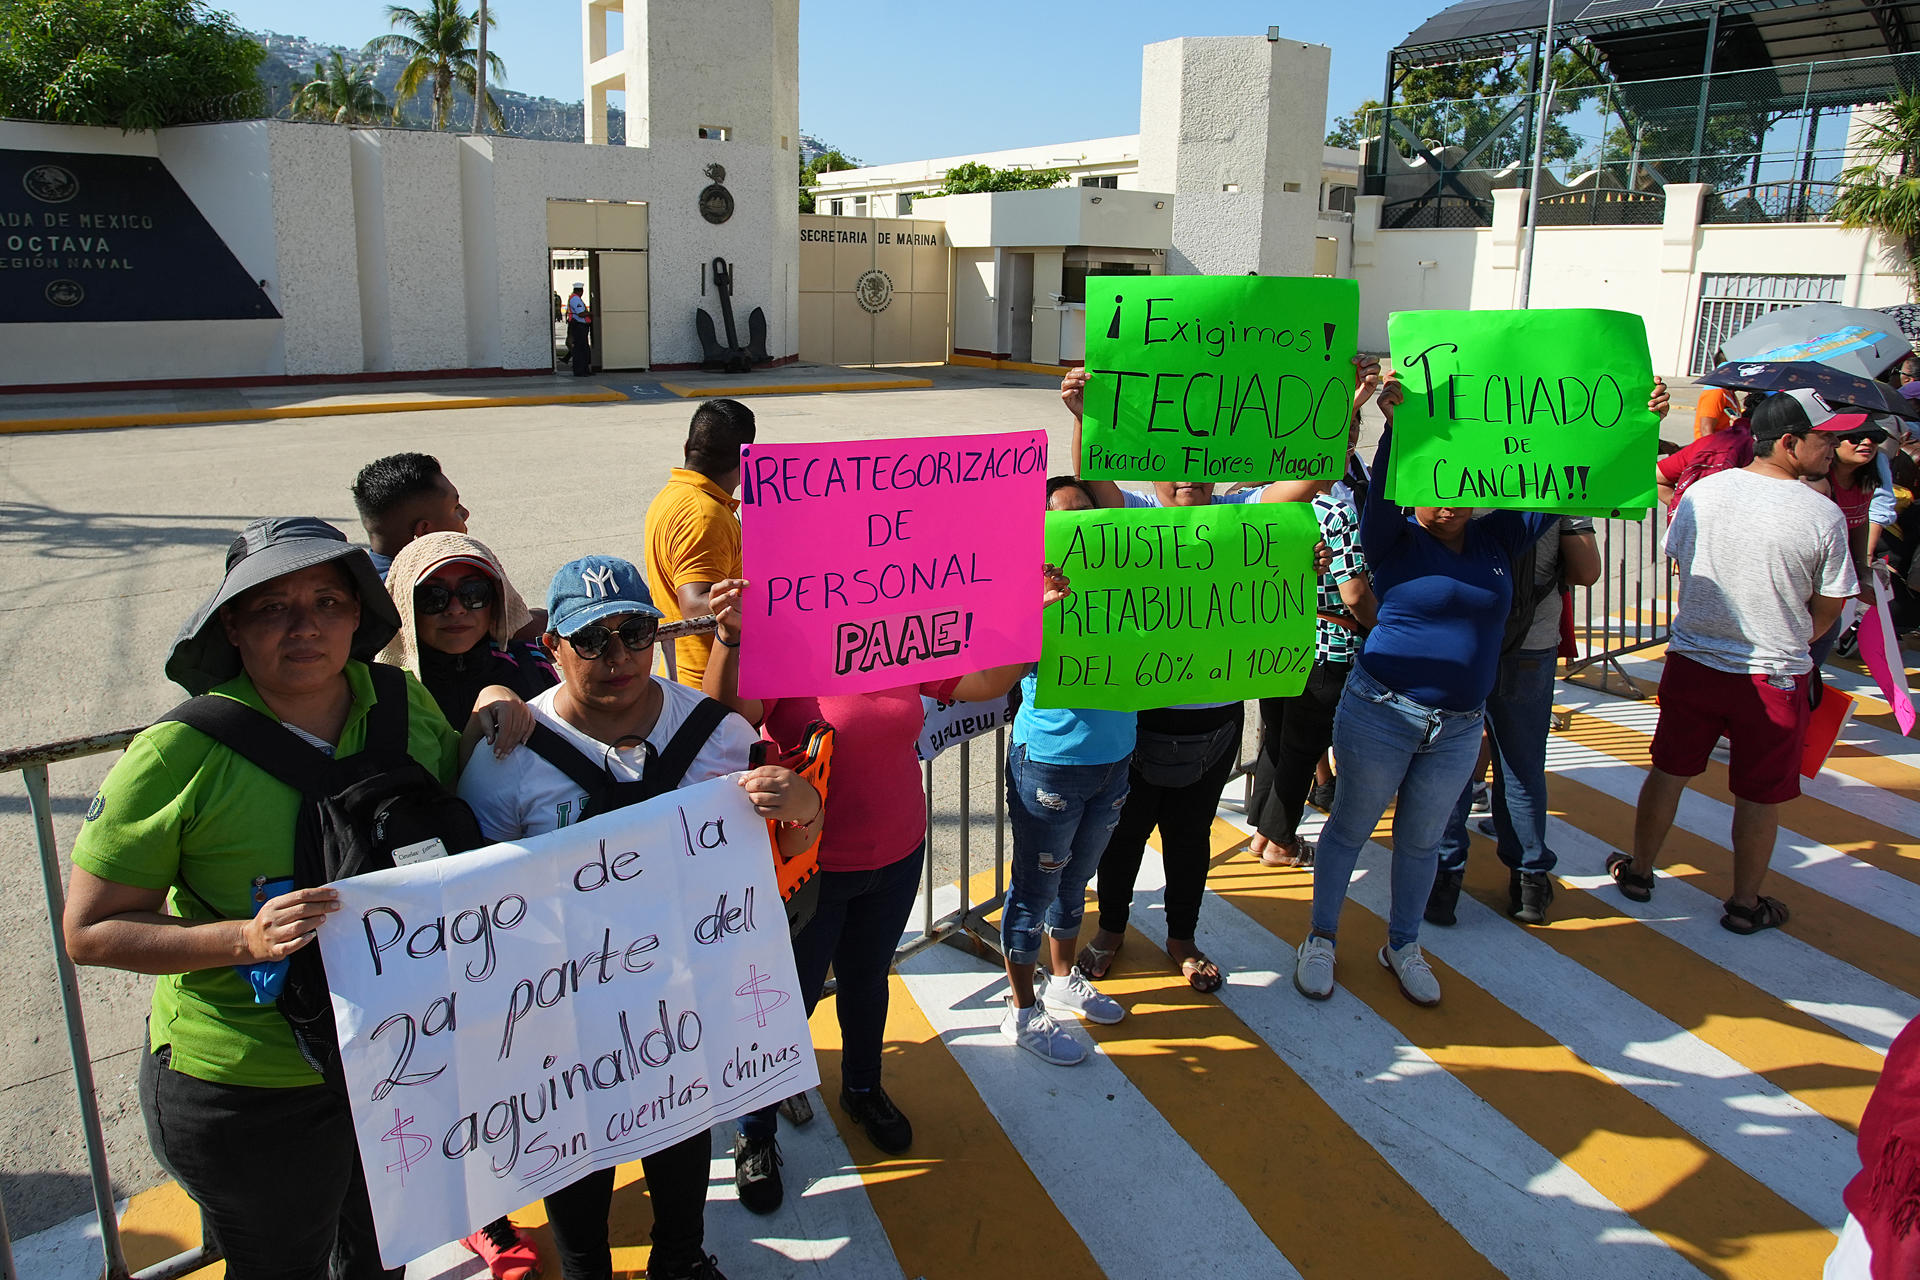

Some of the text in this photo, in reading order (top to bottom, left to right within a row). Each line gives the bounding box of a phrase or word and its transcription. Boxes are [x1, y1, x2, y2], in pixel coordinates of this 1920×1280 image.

[7, 235, 110, 252] OCTAVA
[44, 213, 70, 227] DE
[80, 214, 153, 229] MEXICO
[800, 229, 937, 246] SECRETARIA DE MARINA
[67, 258, 134, 269] NAVAL
[1092, 369, 1350, 439] TECHADO
[1403, 342, 1624, 428] TECHADO
[742, 438, 1048, 507] ¡RECATEGORIZACIÓN
[1089, 444, 1333, 480] Ricardo Flores Magón
[1504, 436, 1532, 455] DE
[1433, 459, 1591, 501] CANCHA!!
[868, 509, 913, 547] DE
[1060, 522, 1279, 570] AJUSTES DE
[767, 552, 993, 617] PERSONAL
[1060, 569, 1305, 637] RETABULACIÓN
[835, 610, 974, 675] PAAE!
[1057, 646, 1311, 687] DEL 60% al 100%
[361, 805, 728, 982] Pago de la
[497, 928, 660, 1062] parte
[442, 999, 703, 1179] aguinaldo
[523, 1041, 802, 1174] Sin cuentas chinas
